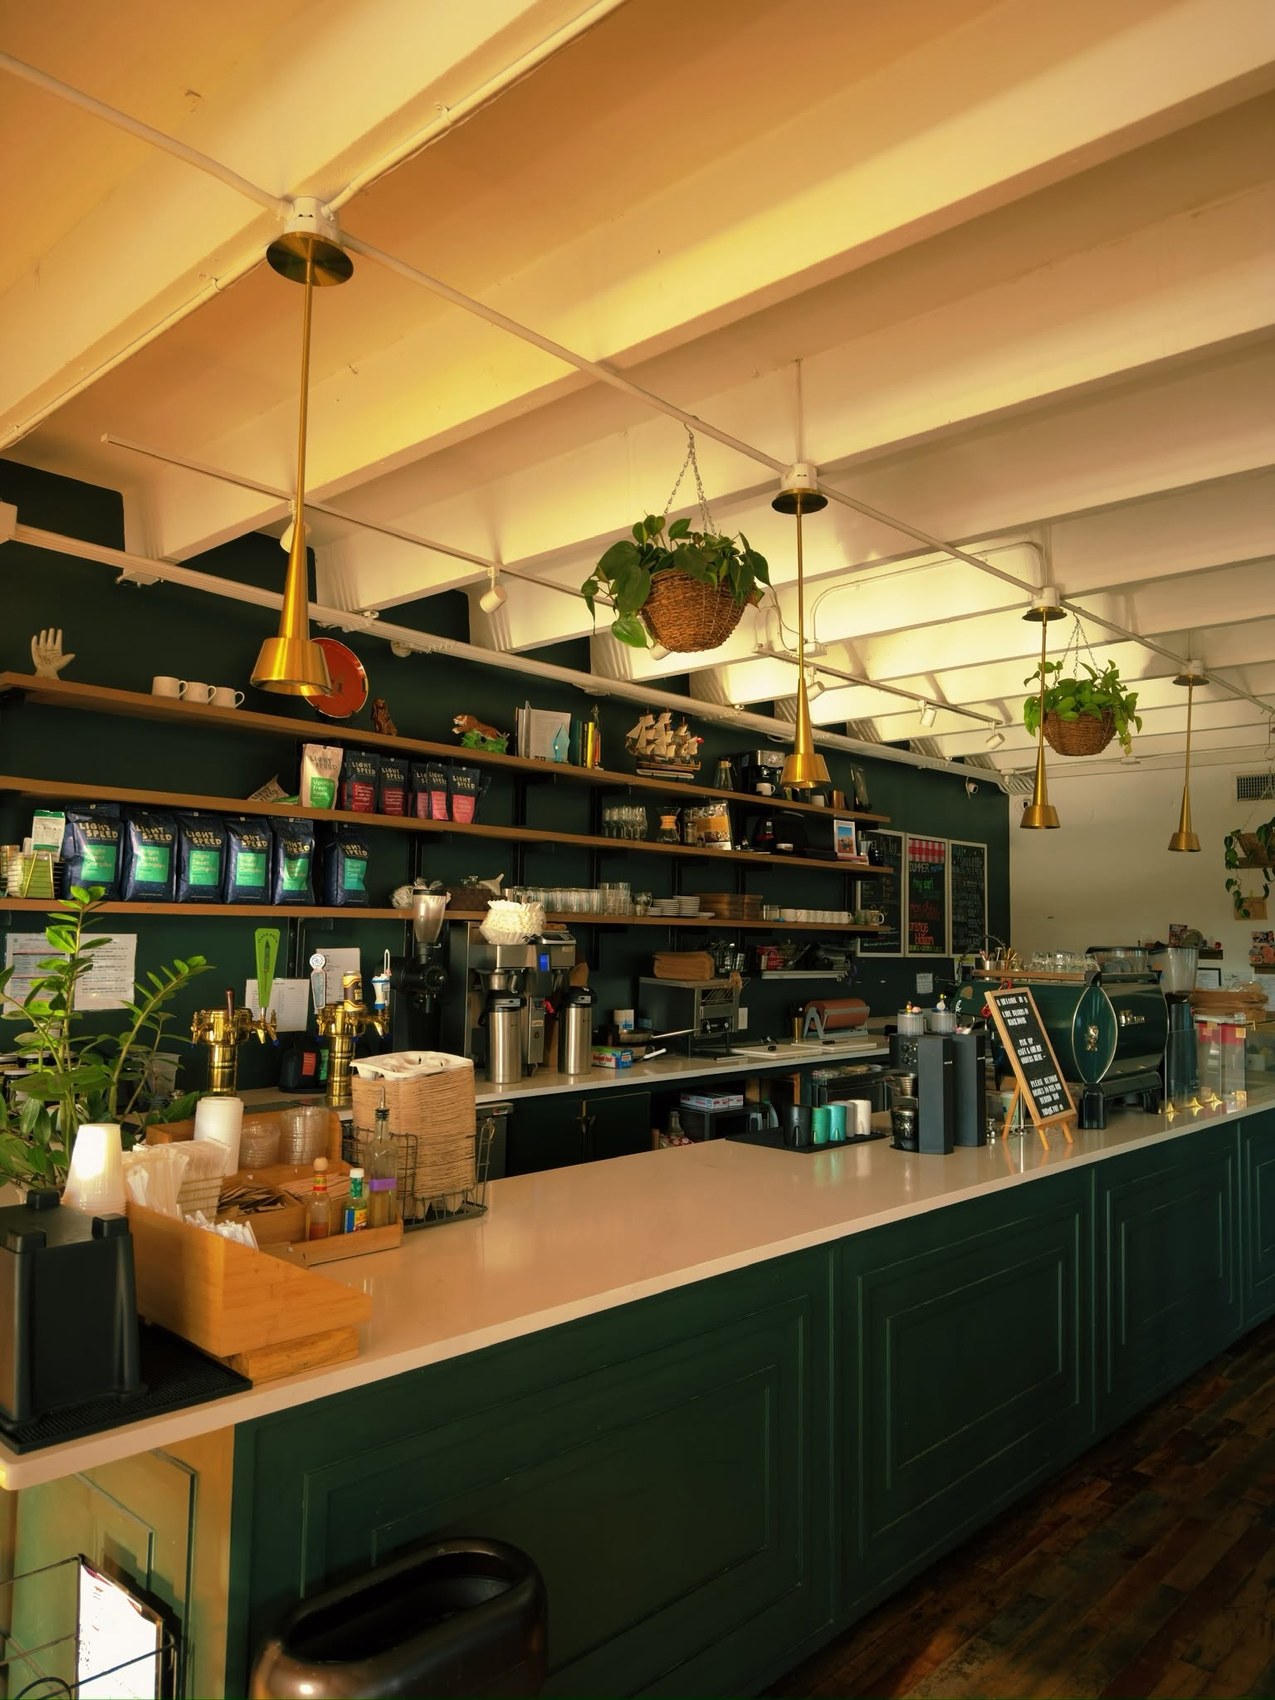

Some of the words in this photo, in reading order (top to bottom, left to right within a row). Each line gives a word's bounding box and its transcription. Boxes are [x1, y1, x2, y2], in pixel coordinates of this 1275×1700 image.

[309, 755, 332, 763] LIGHT
[356, 767, 376, 775] SPEED
[452, 775, 471, 783] LIGHT
[456, 781, 475, 789] SPEED
[78, 822, 110, 831] LIGHT
[135, 825, 164, 834] LIGHT
[86, 829, 118, 838] SPEED
[142, 832, 172, 841] SPEED
[185, 830, 214, 838] LIGHT
[192, 837, 222, 845] SPEED
[241, 839, 268, 847] SPEED
[909, 862, 929, 873] SUMMER
[1031, 1079, 1043, 1088] PLEASE
